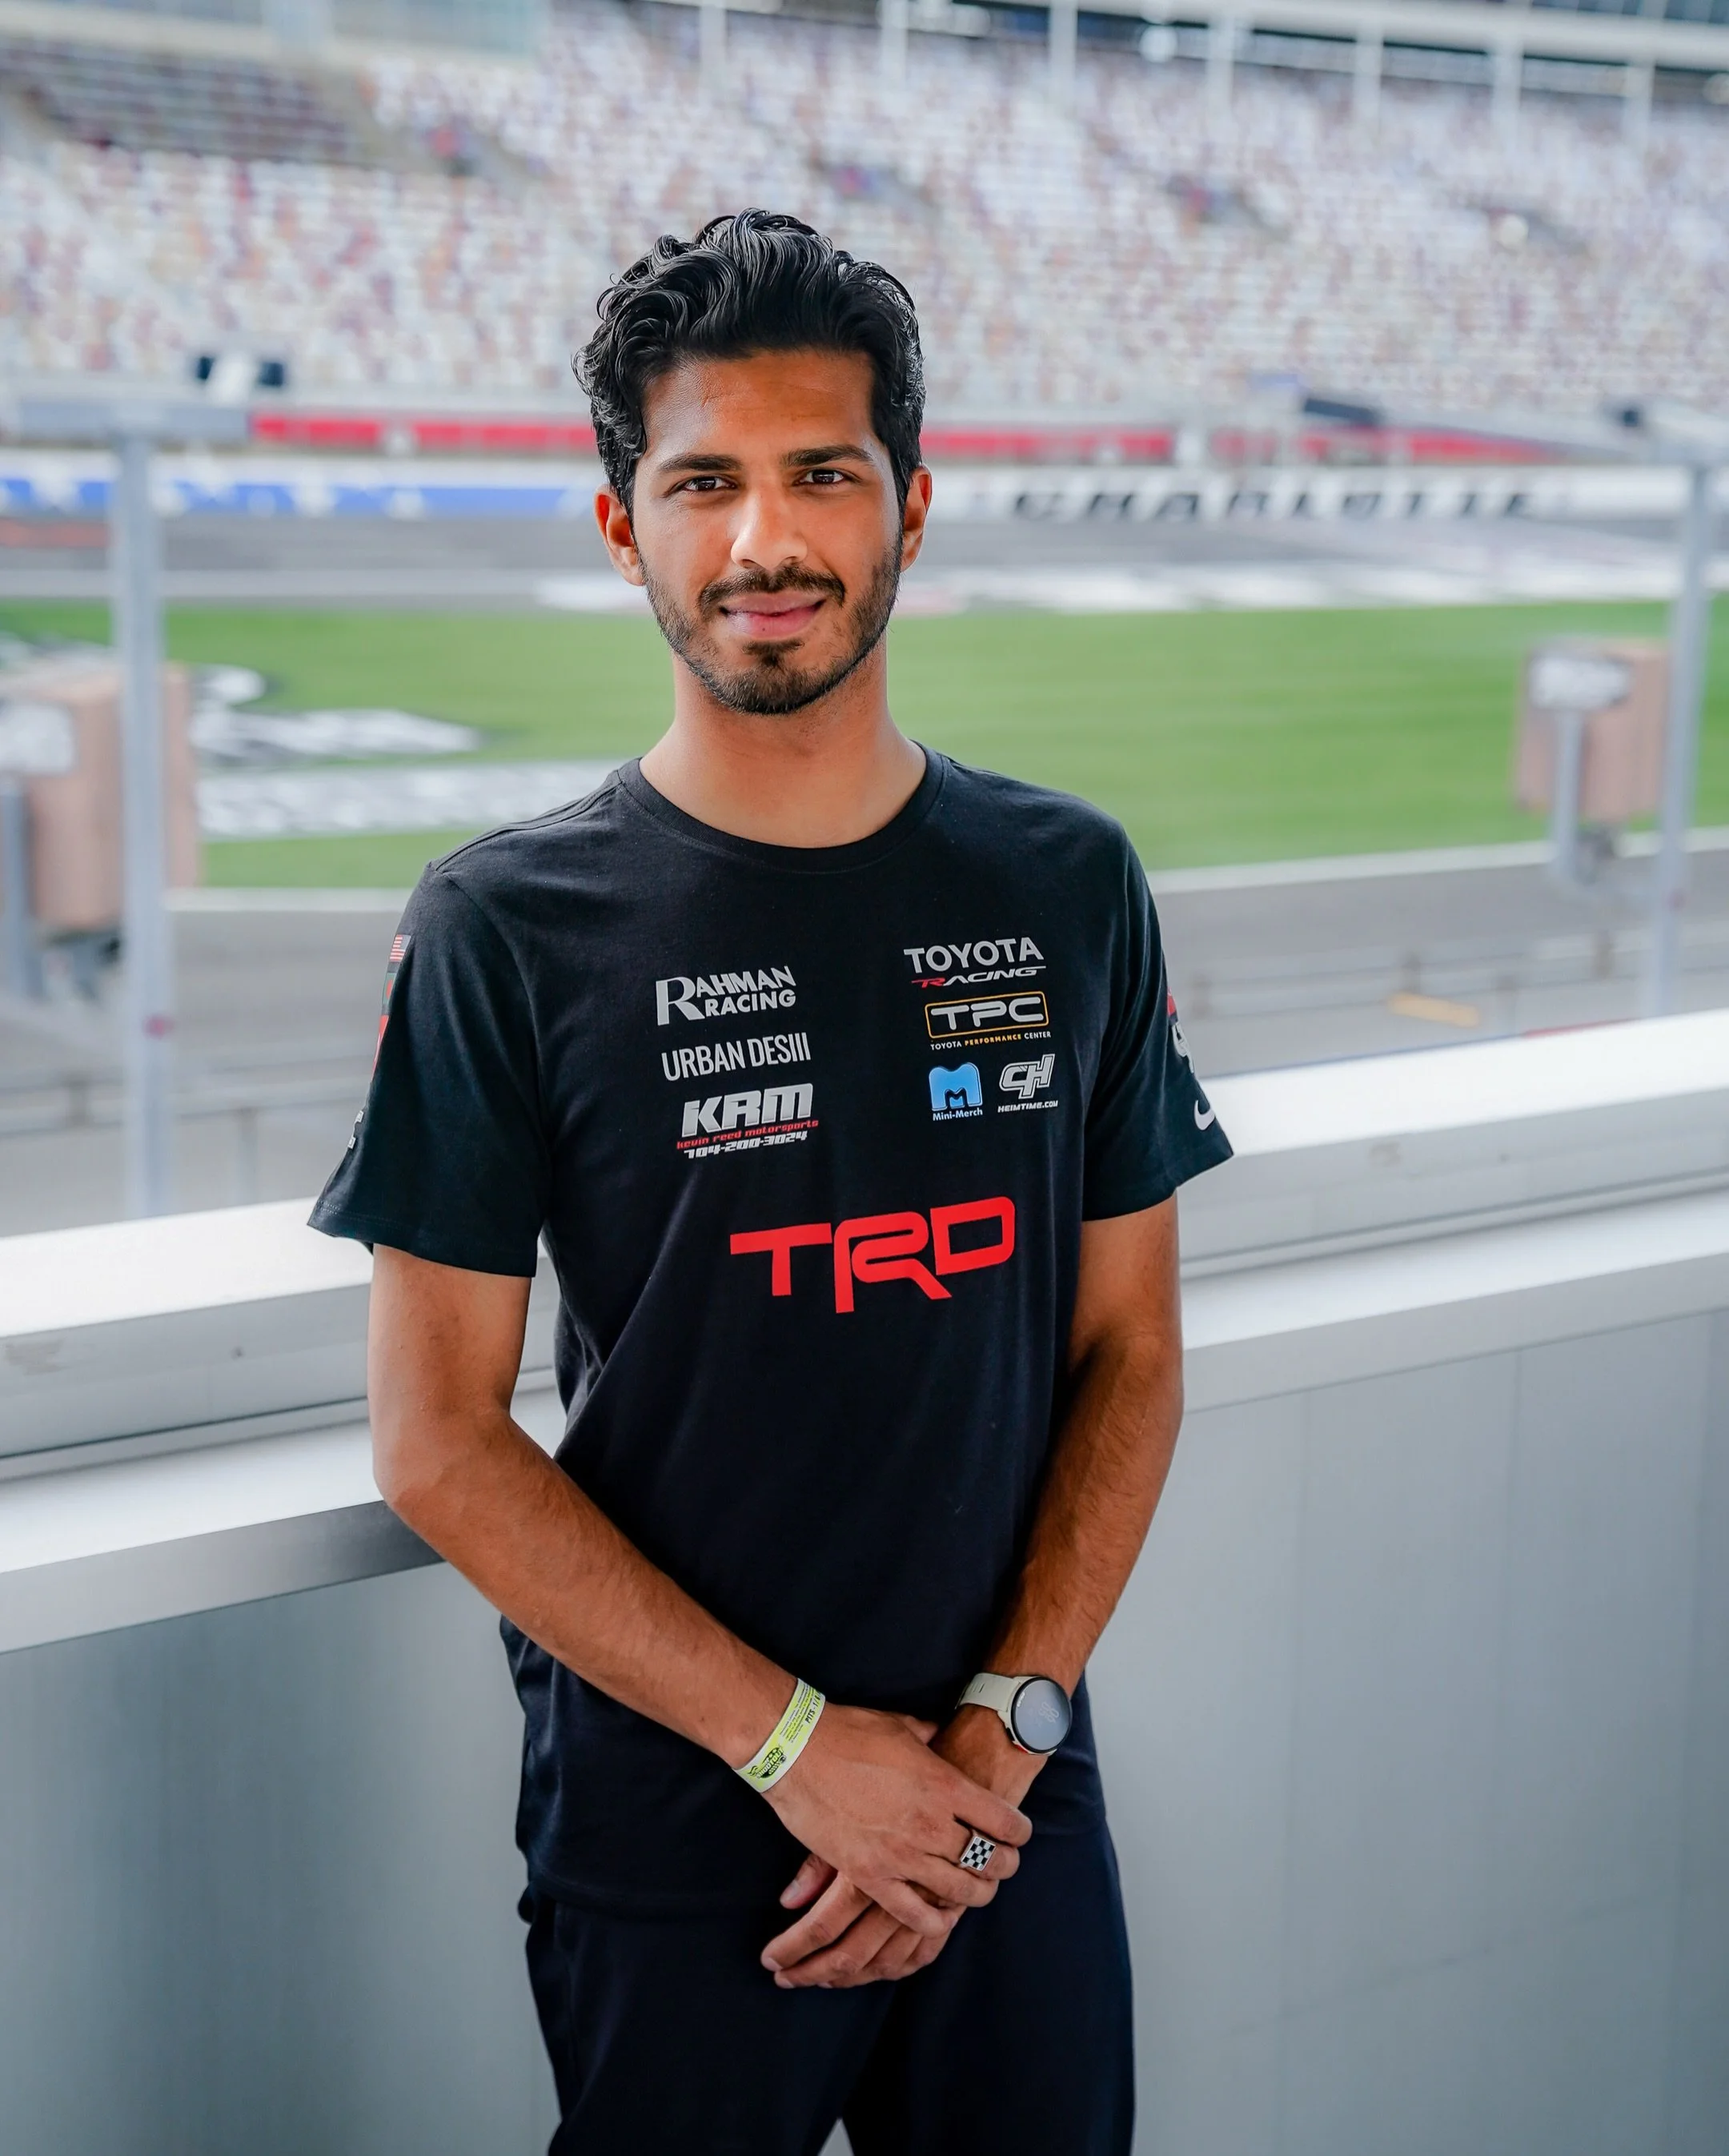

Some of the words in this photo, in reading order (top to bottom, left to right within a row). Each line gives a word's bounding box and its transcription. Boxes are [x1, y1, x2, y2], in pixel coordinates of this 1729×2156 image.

[904, 937, 1044, 974] TOYOTA
[912, 966, 1046, 988] RACING
[656, 966, 796, 1026] RAHMAN
[704, 990, 796, 1017] RACING
[931, 997, 1044, 1030] TPC
[930, 1041, 962, 1050] TOYOTA
[965, 1034, 1021, 1046] PERFORMANCE
[1024, 1031, 1051, 1040] CENTER
[661, 1041, 745, 1081] URBAN
[682, 1083, 813, 1138] KRM
[933, 1108, 983, 1121] Mini-Merch
[684, 1130, 808, 1159] 704-200-3024
[712, 1130, 742, 1142] reed
[744, 1120, 819, 1137] motorsports
[730, 1196, 1015, 1313] TRD
